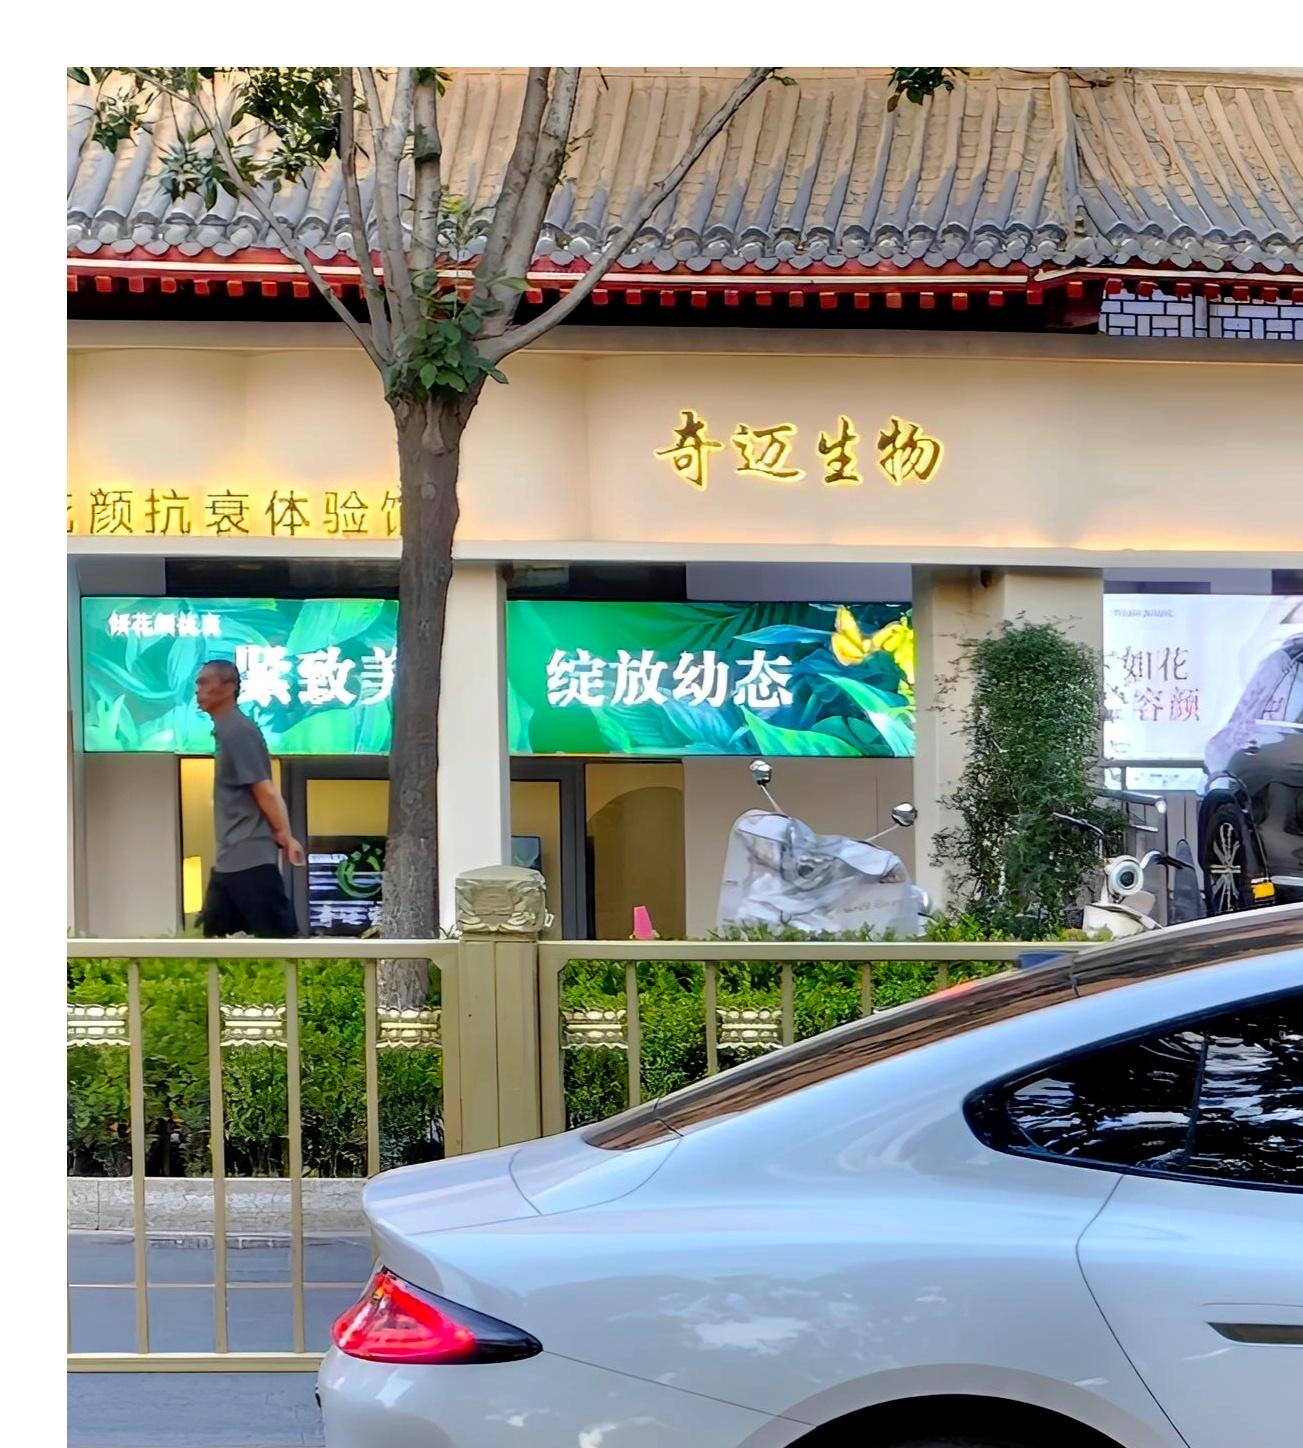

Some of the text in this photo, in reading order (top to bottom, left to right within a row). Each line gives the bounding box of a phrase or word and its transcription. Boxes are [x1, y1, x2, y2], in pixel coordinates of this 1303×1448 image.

[655, 408, 943, 487] 奇迈生物
[67, 488, 401, 536] 颜抗衰体验
[545, 648, 794, 708] 绽放幼态
